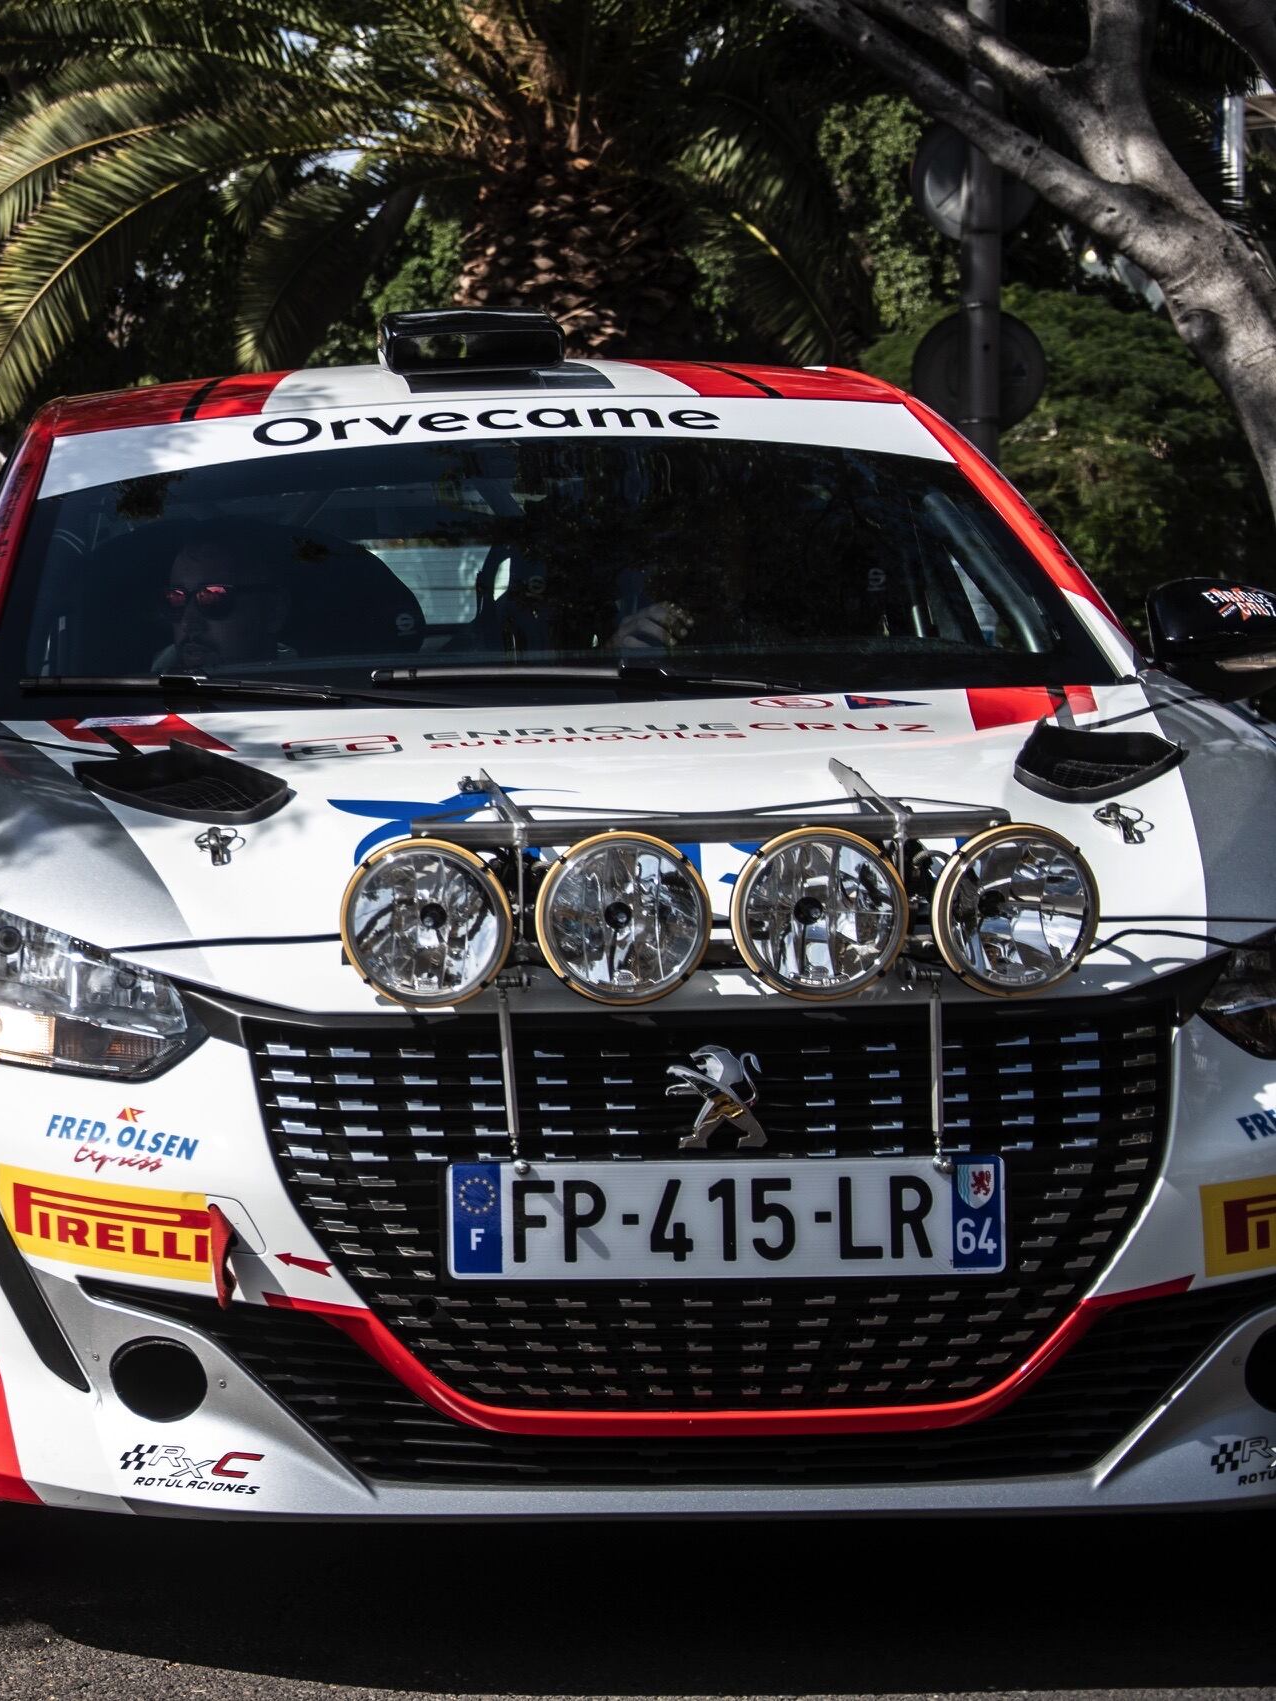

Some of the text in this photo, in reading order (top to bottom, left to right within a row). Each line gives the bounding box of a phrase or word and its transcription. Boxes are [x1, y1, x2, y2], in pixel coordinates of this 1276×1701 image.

[253, 407, 722, 447] Orvecame
[423, 722, 936, 741] ENRIQUE CRUZ
[117, 1126, 199, 1161] OLSEN
[13, 1182, 211, 1263] PIRELLI
[470, 1229, 484, 1251] F
[956, 1217, 997, 1254] 64
[133, 1477, 260, 1495] ROTULACIONES
